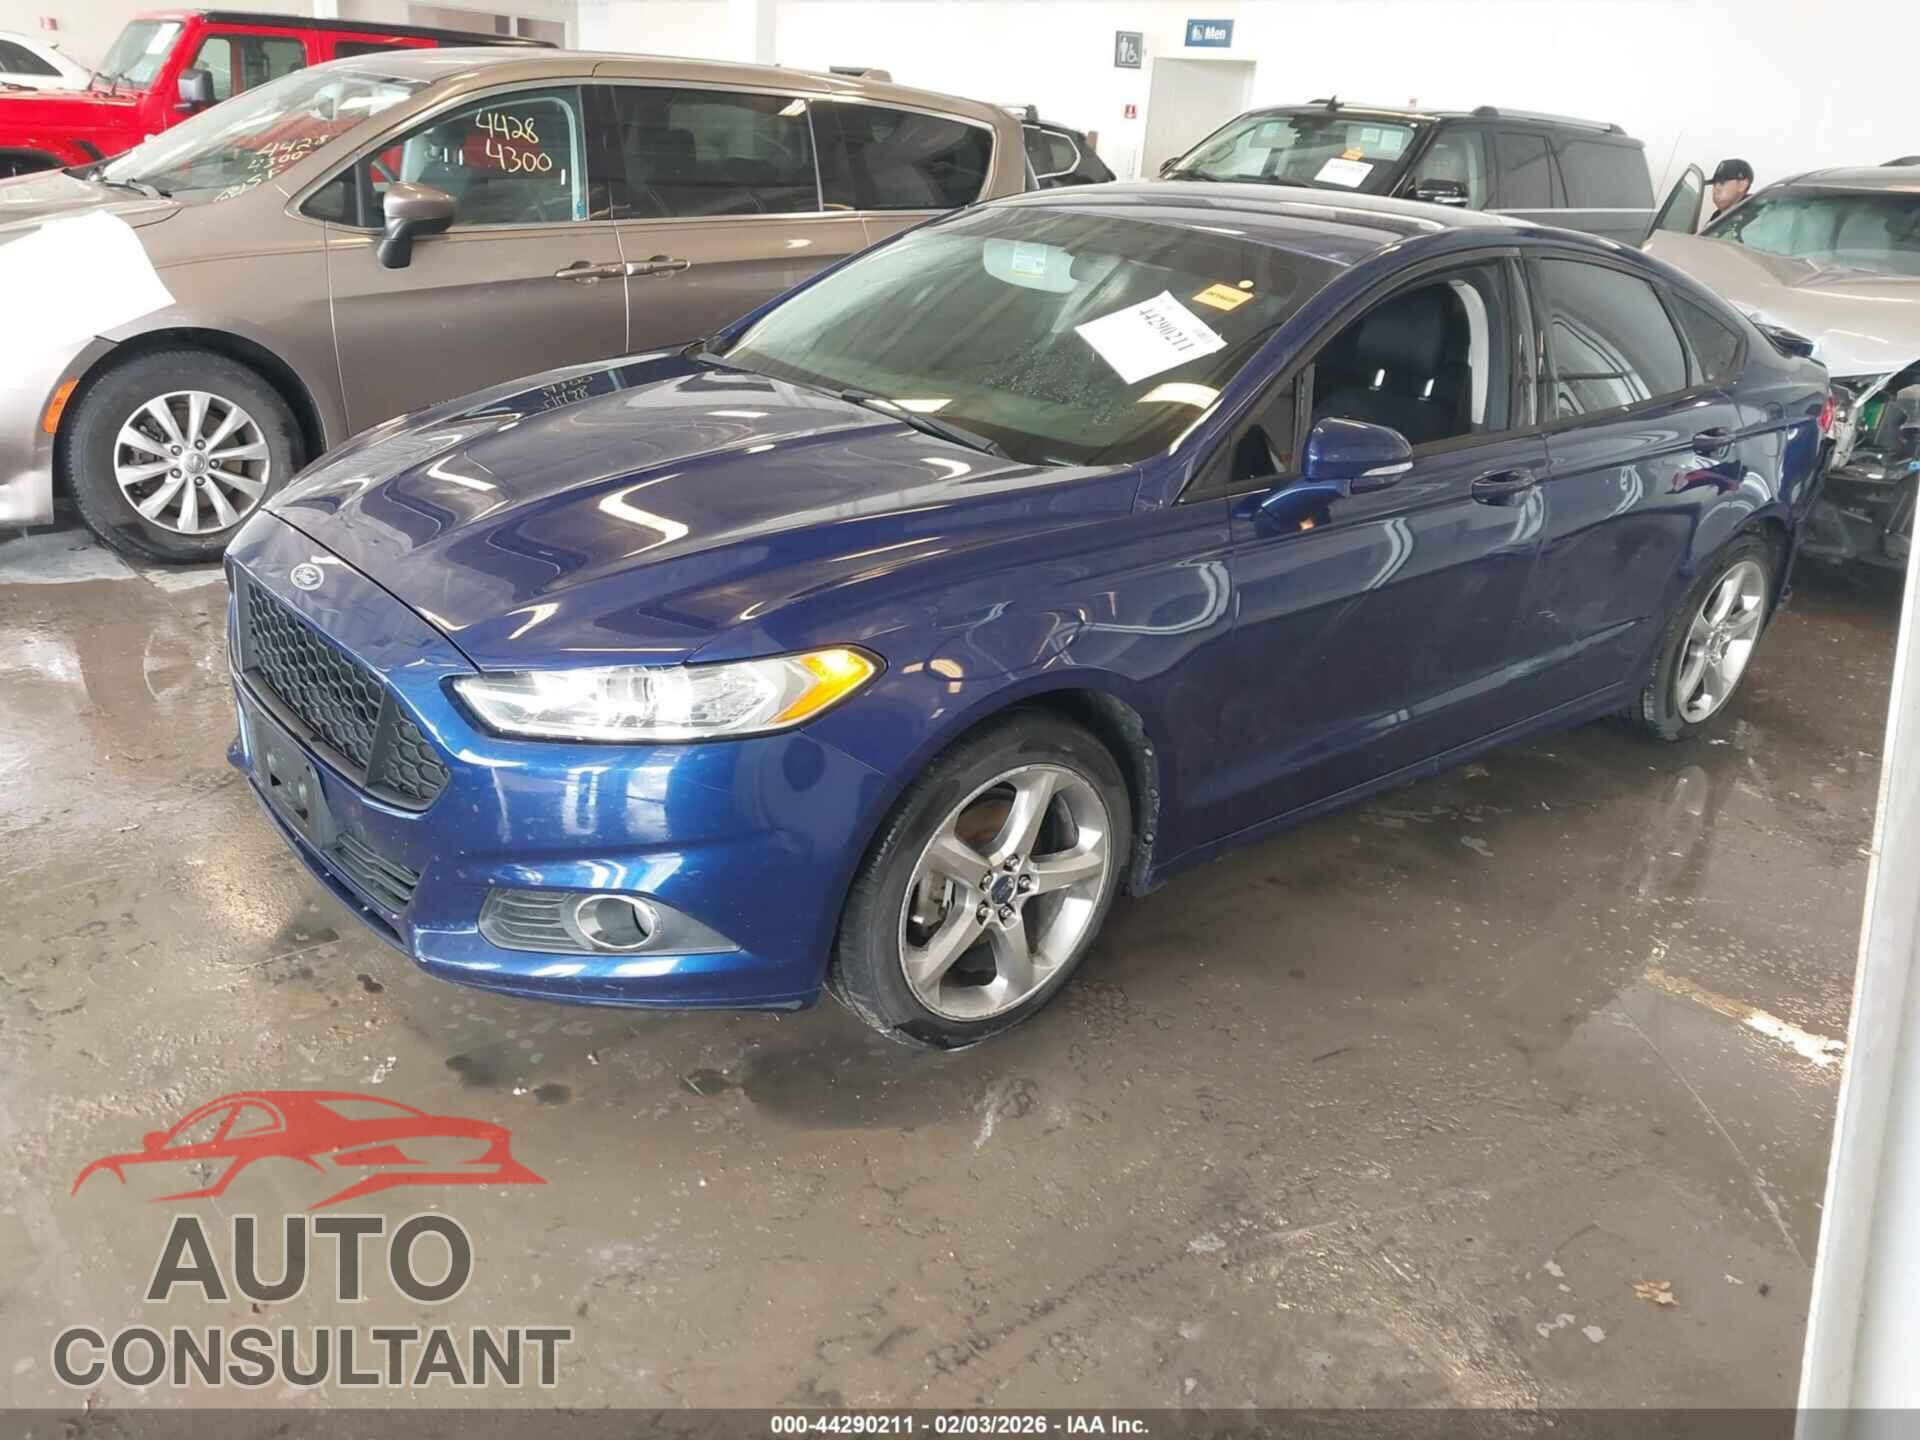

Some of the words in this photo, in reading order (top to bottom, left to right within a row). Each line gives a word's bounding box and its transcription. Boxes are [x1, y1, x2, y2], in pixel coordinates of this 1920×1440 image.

[1204, 26, 1226, 40] Men
[476, 108, 539, 144] 4428
[486, 139, 552, 172] 4300
[1139, 309, 1195, 351] 44290211
